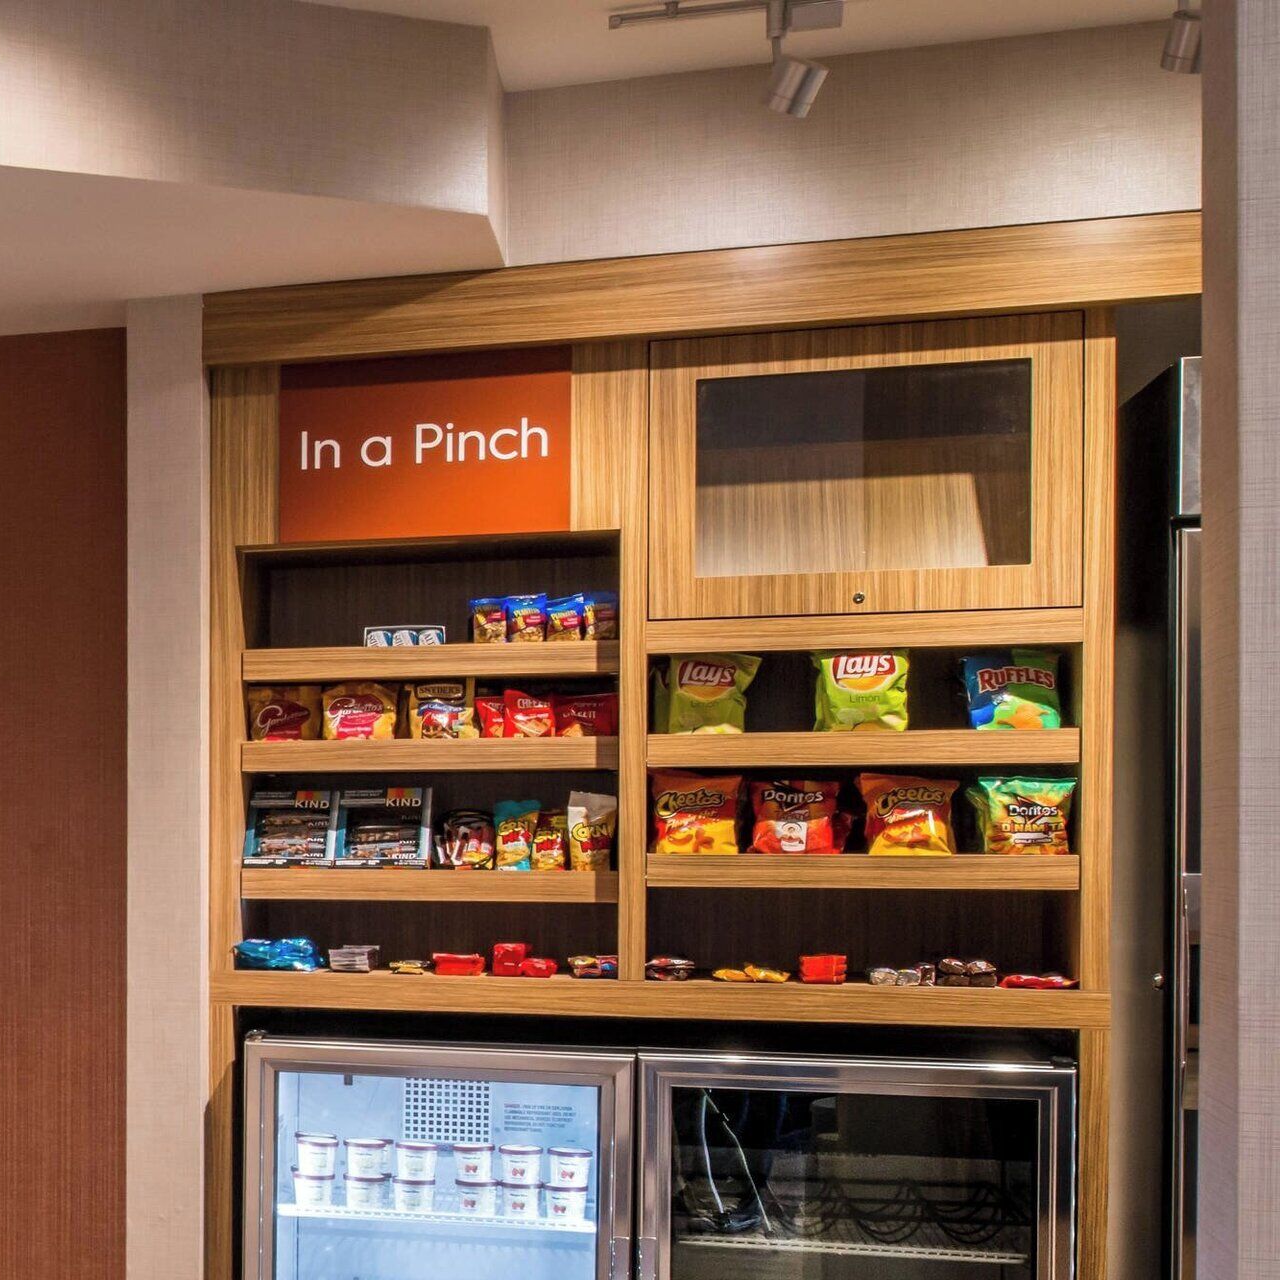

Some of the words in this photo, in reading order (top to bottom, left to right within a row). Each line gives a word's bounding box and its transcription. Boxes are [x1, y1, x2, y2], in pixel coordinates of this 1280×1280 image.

[300, 431, 340, 471] In
[359, 435, 393, 468] a
[414, 416, 550, 465] Pinch
[976, 666, 1056, 694] RUFFLES
[294, 800, 330, 809] KIND
[385, 798, 422, 807] KIND
[654, 787, 725, 819] Cheetos
[763, 790, 824, 804] Doritos
[874, 787, 948, 818] Cheetos
[1008, 804, 1058, 816] Doritos
